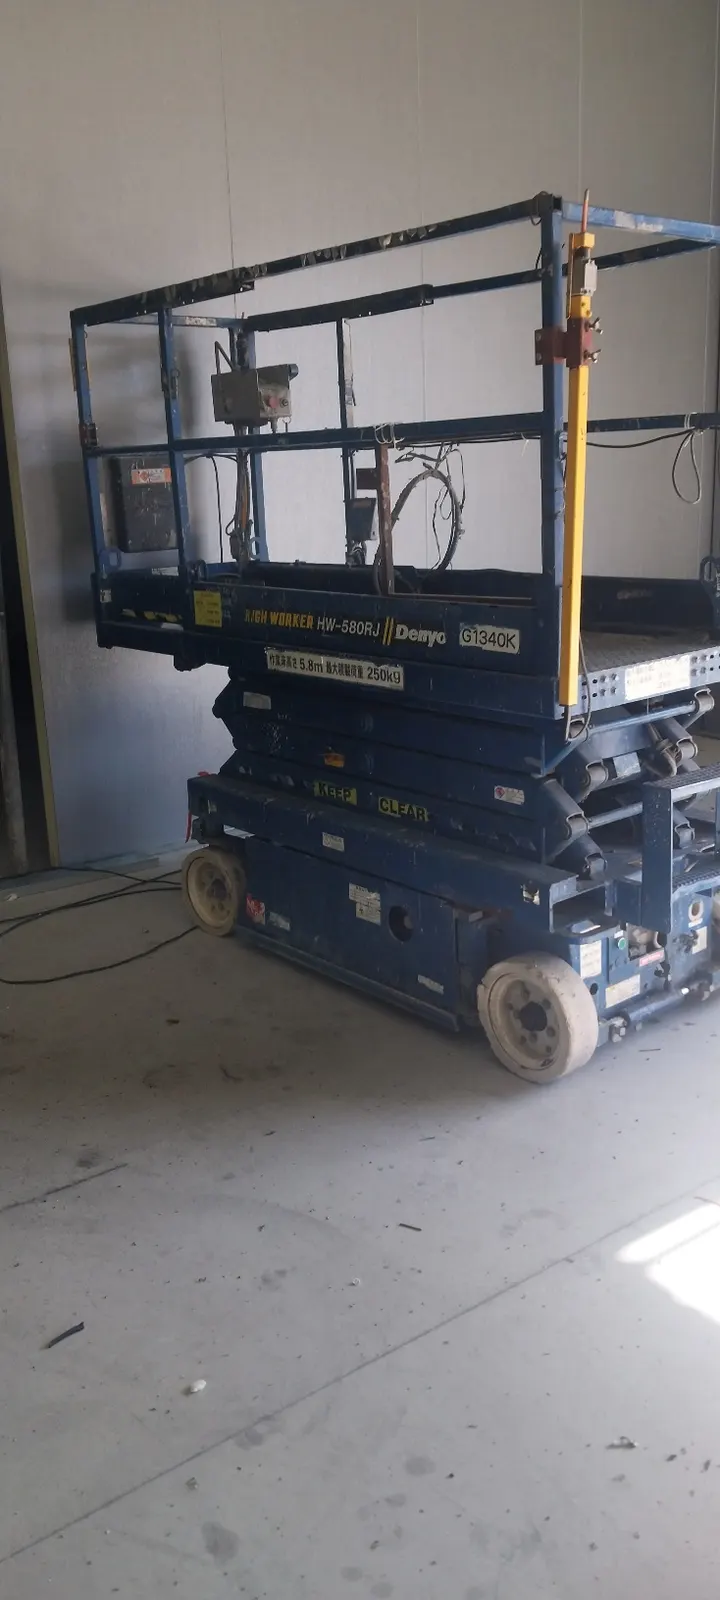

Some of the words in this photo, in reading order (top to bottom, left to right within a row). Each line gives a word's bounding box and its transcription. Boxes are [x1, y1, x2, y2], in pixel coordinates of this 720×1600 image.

[270, 611, 313, 629] WORKER
[316, 616, 380, 638] HW-580RJ
[395, 624, 446, 647] Denyo
[462, 628, 516, 649] G1340K
[300, 657, 323, 673] 5.8m
[367, 666, 401, 684] 250kg
[318, 782, 352, 802] KEEP
[380, 798, 428, 821] CLEAR
